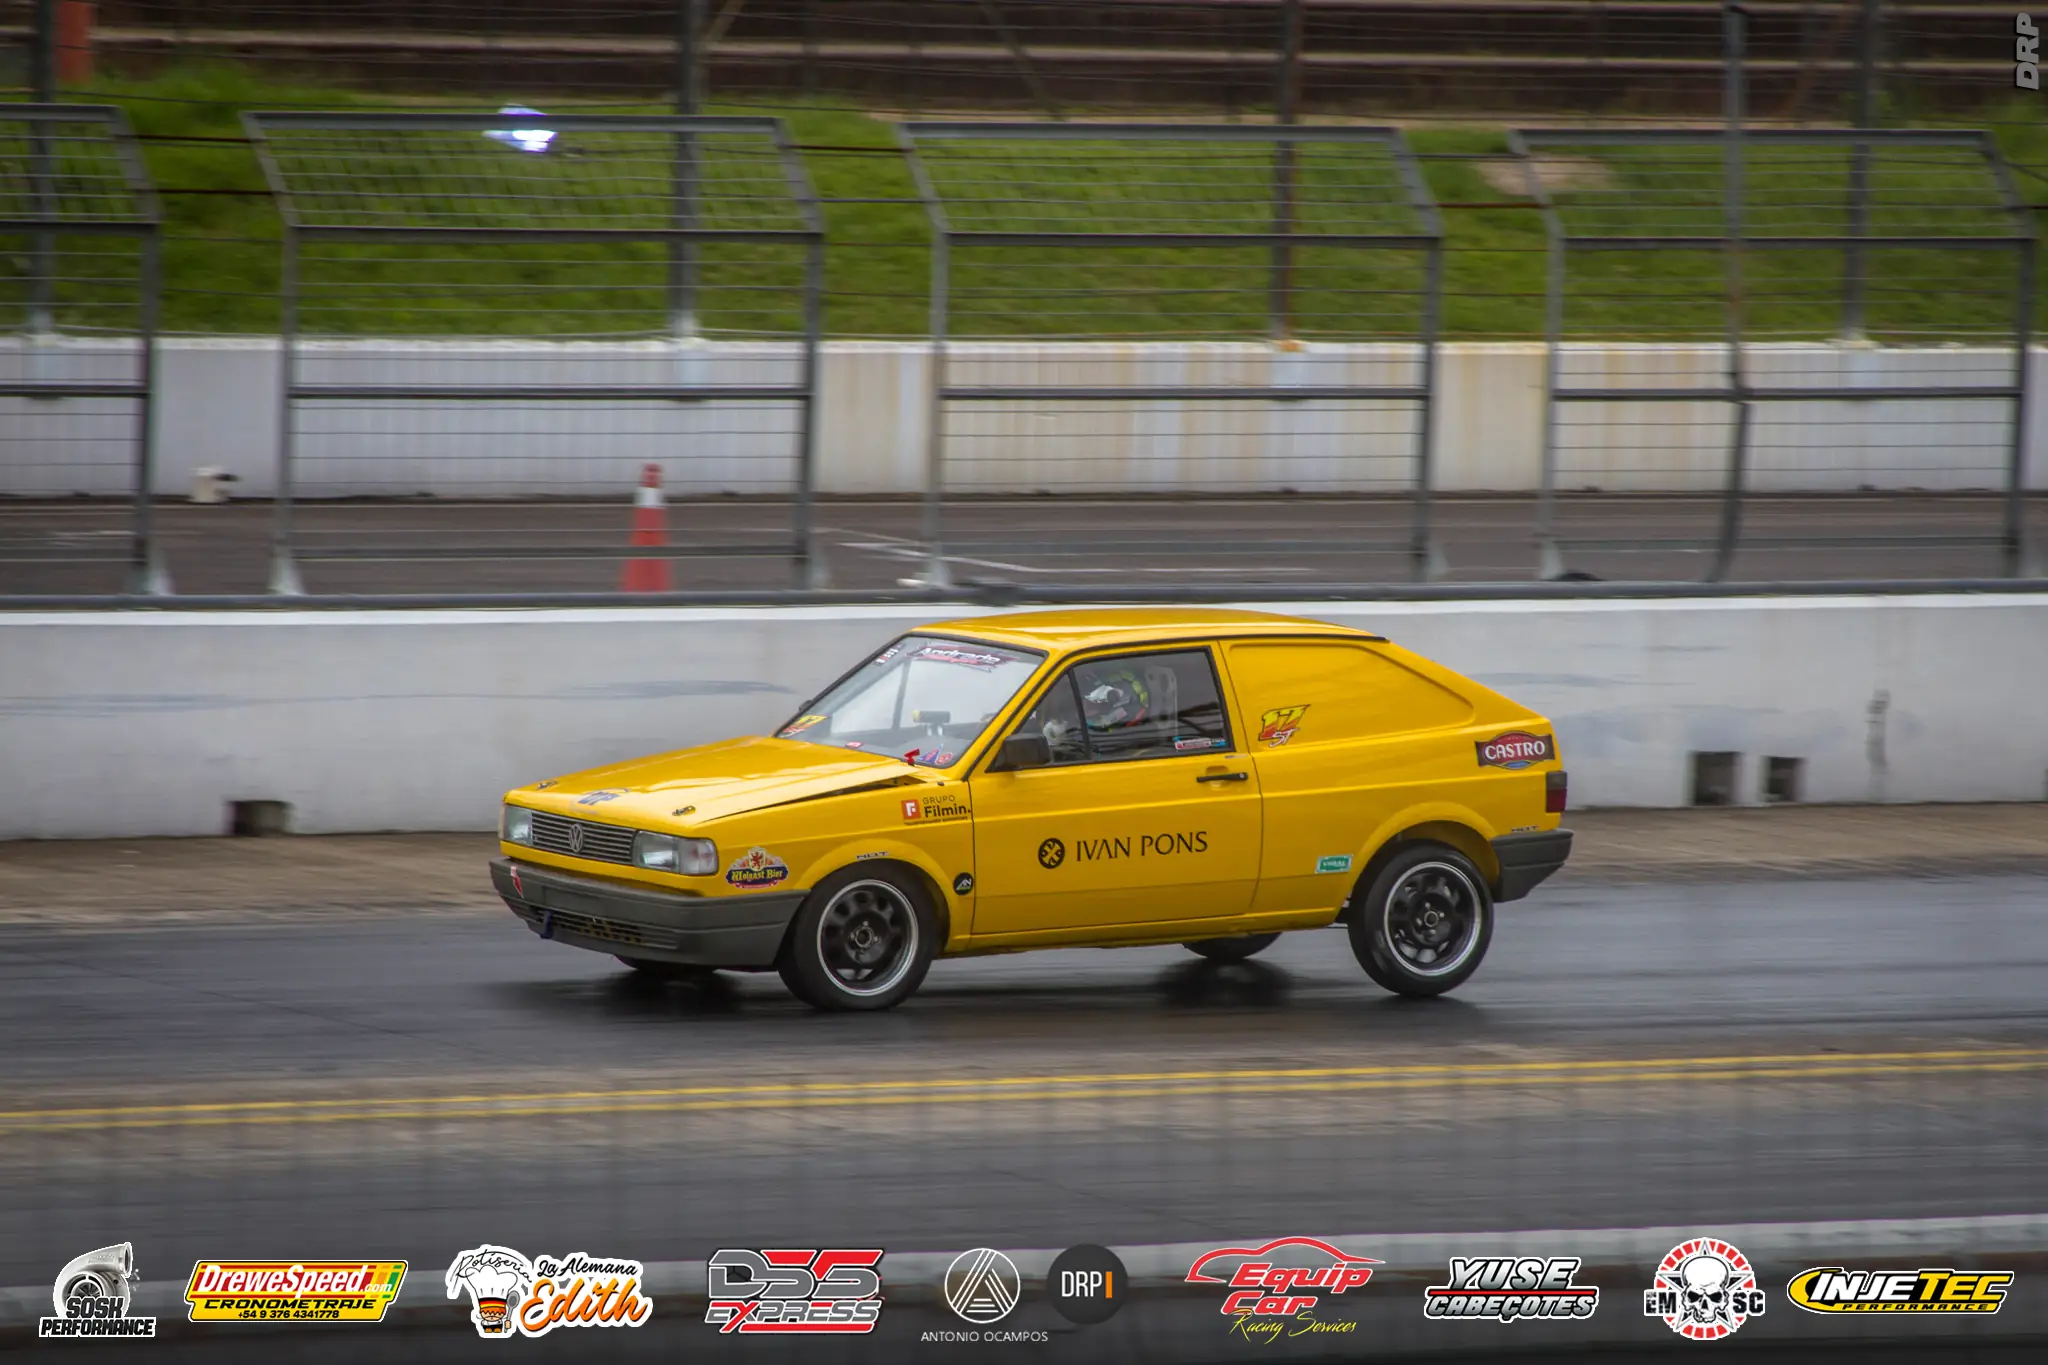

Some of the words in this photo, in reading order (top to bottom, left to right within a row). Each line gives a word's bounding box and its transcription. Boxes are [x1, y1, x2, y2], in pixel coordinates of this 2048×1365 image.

[1484, 740, 1545, 760] CASTRO
[922, 795, 956, 804] GRUPO
[1076, 837, 1131, 862] IVAN
[1141, 831, 1208, 857] PONS
